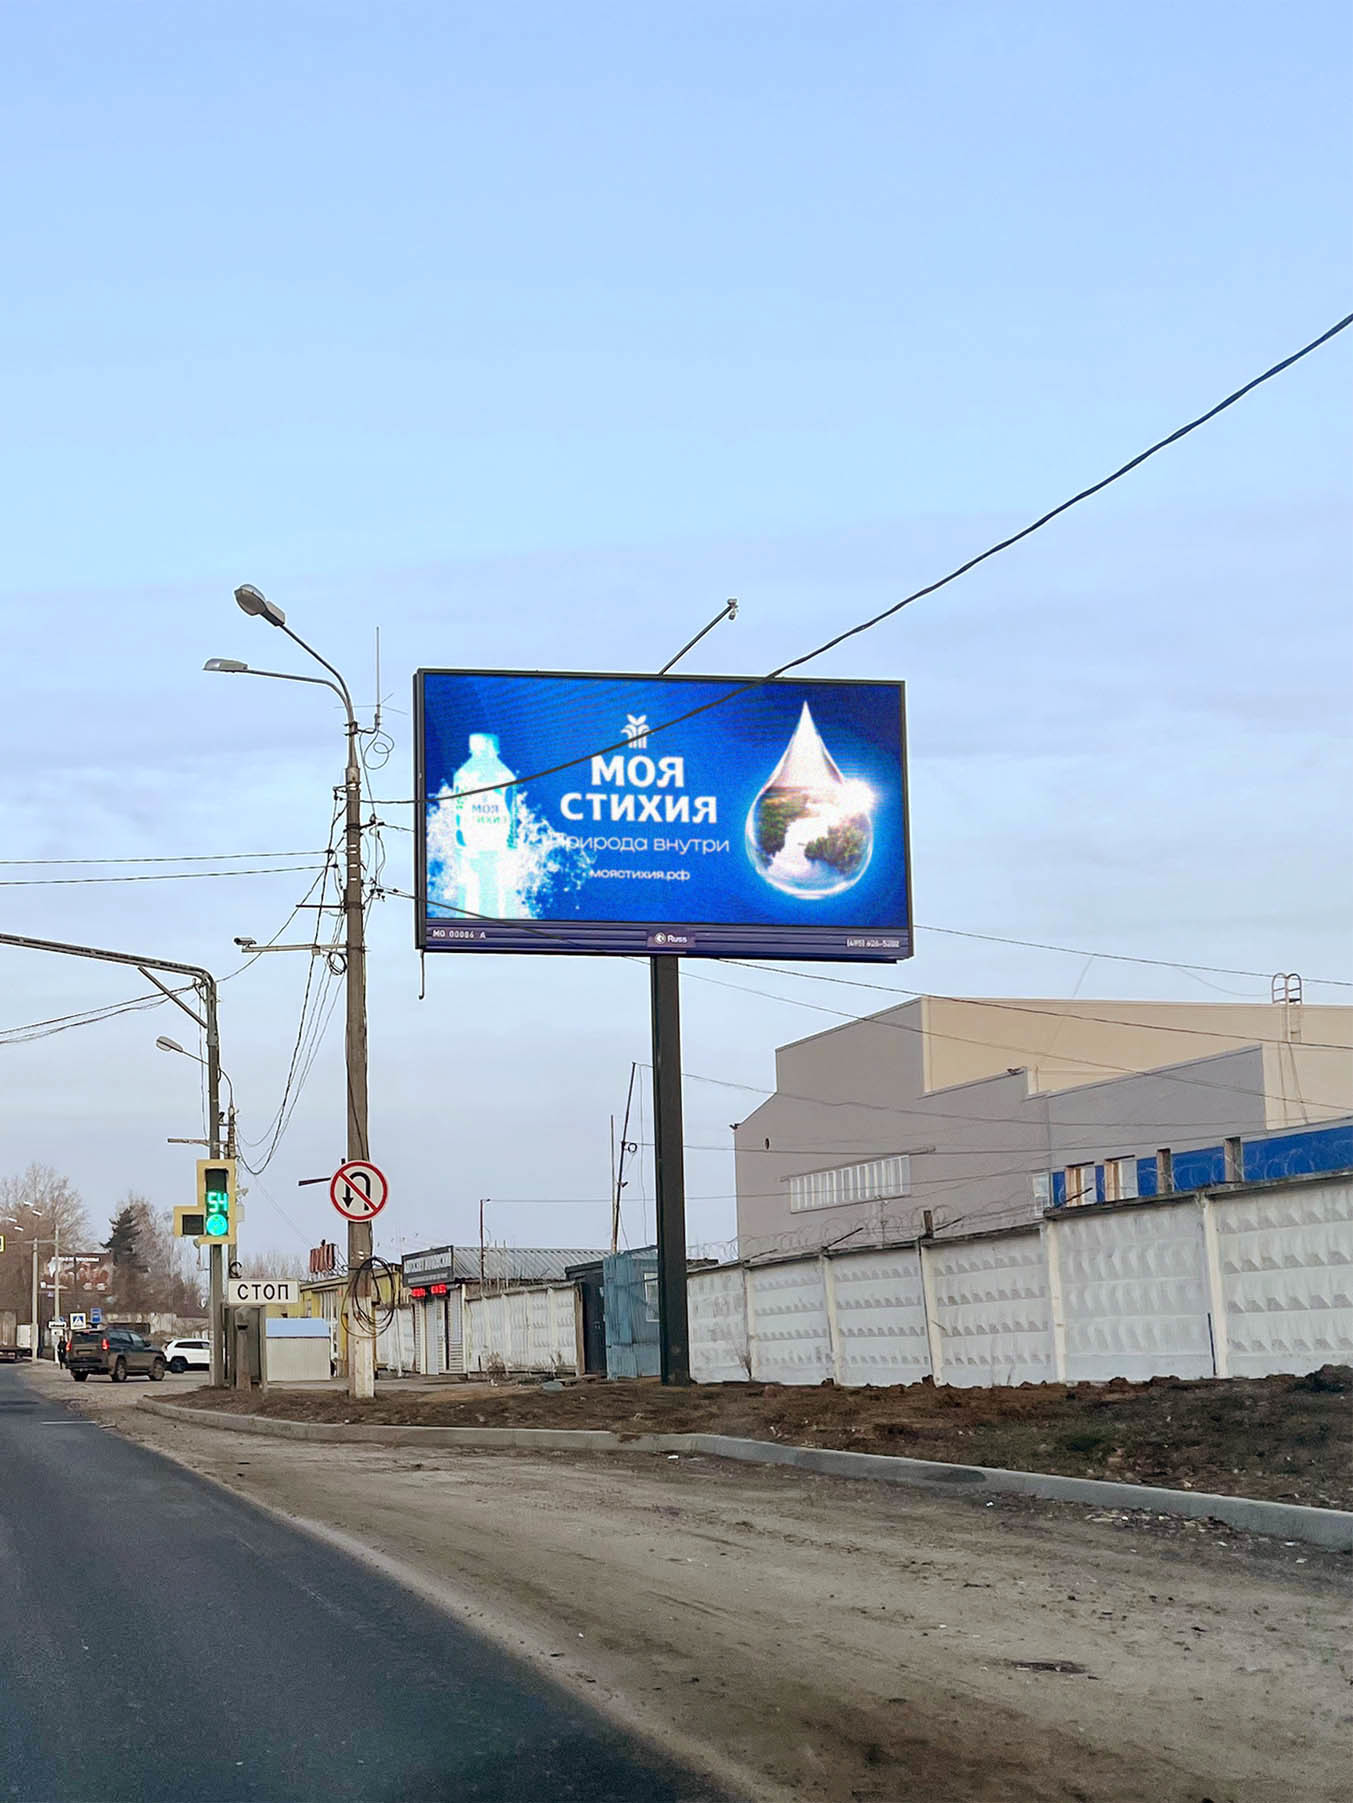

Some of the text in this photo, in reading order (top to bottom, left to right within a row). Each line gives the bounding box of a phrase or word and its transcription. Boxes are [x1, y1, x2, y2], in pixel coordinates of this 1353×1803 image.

[591, 755, 684, 788] МОЯ
[560, 792, 717, 824] СТИХИЯ
[653, 838, 730, 855] внутри
[207, 1192, 228, 1213] 54
[237, 1283, 289, 1301] СТОП
